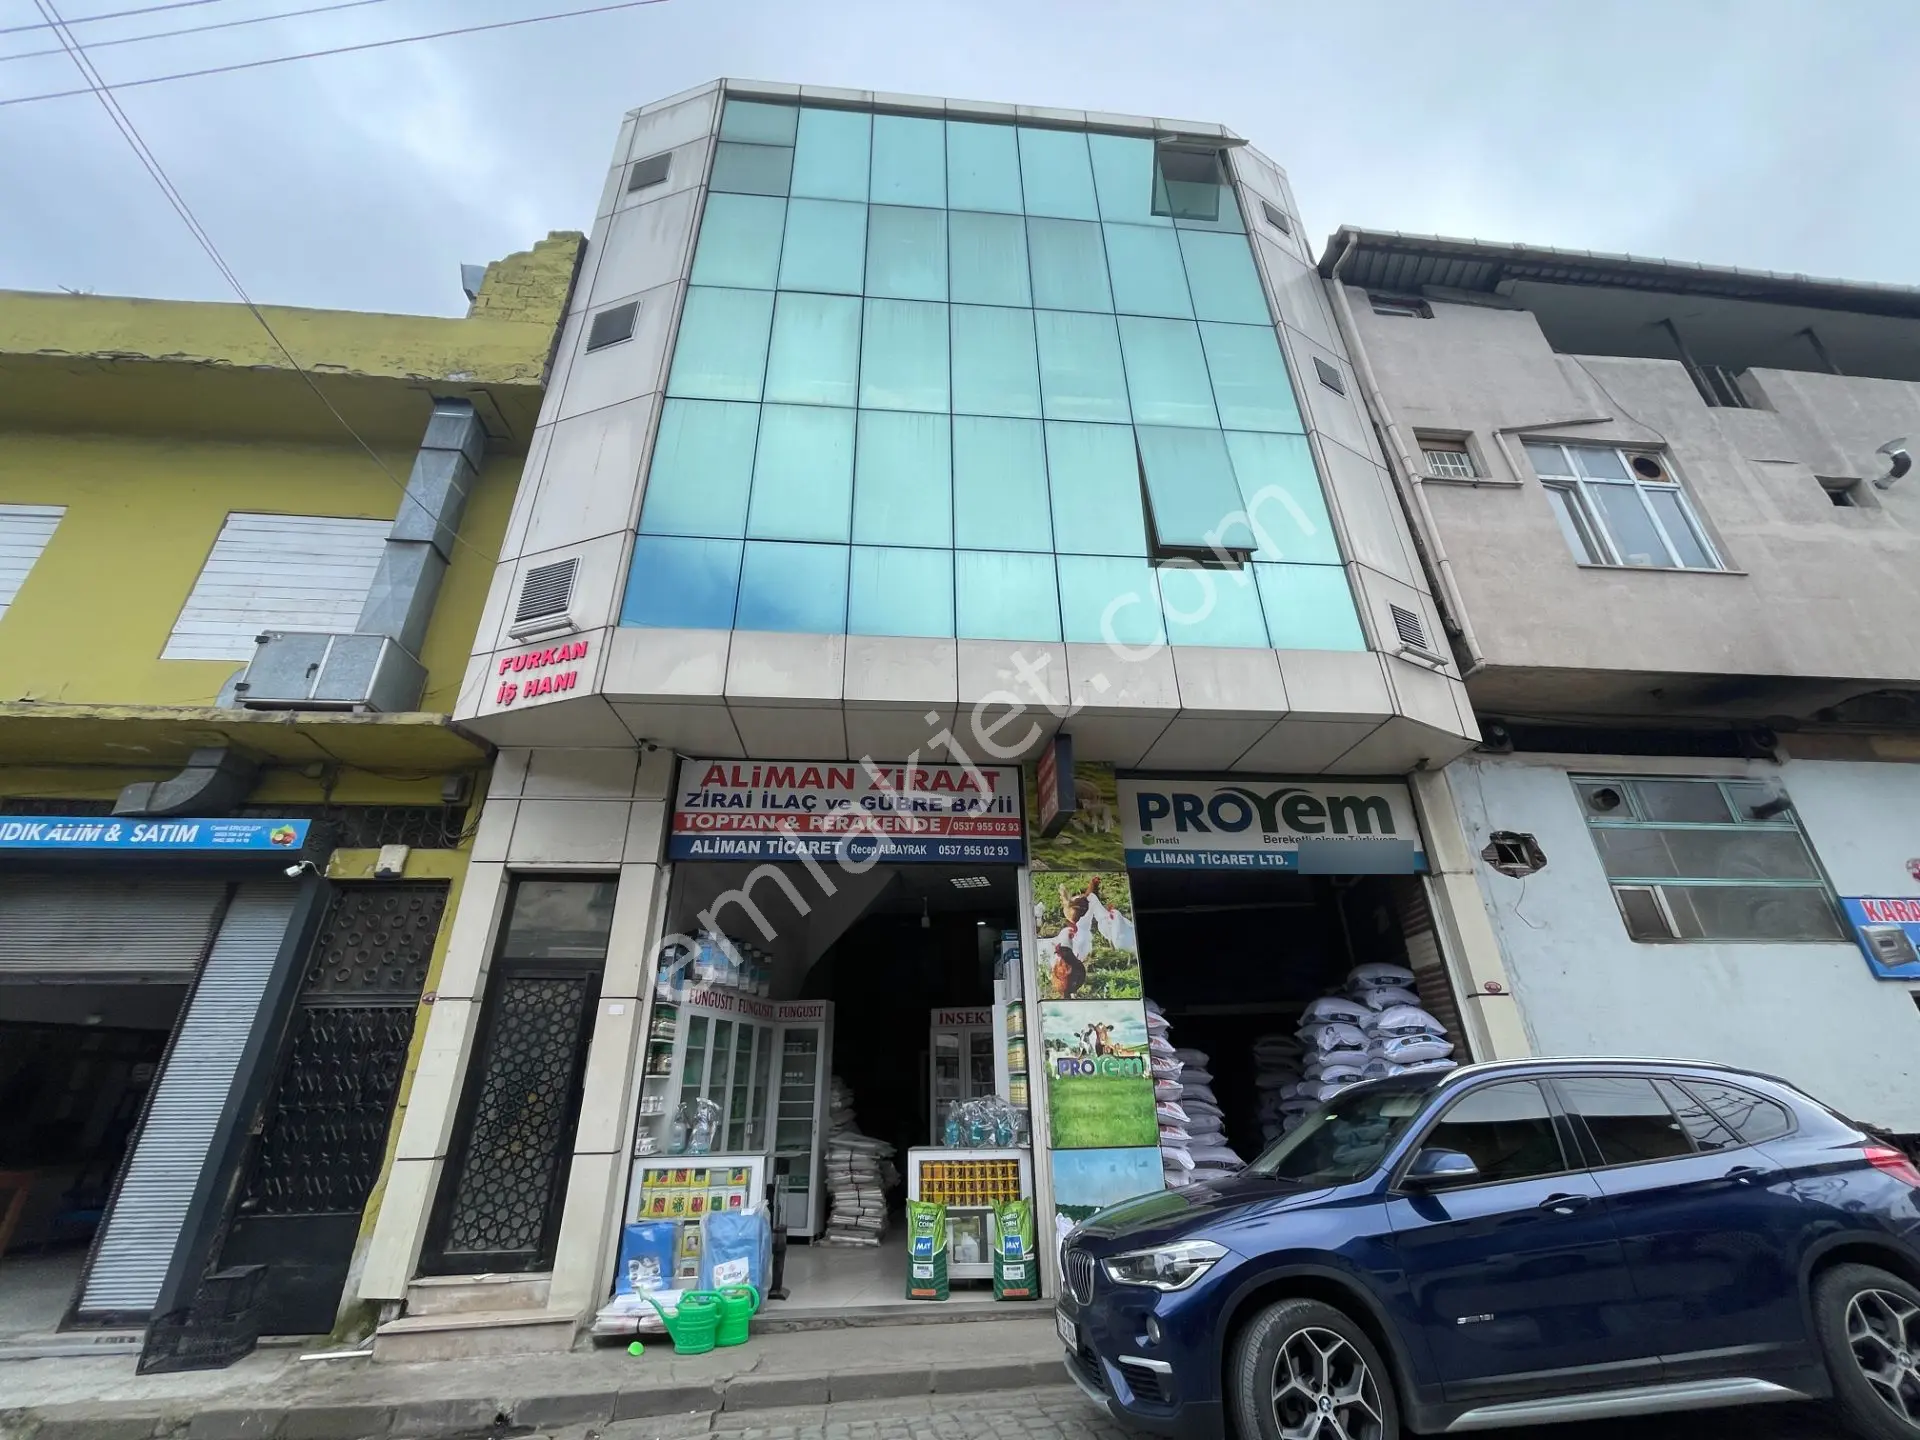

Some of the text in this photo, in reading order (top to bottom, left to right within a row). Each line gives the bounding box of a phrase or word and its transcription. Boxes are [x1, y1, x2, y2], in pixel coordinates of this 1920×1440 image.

[499, 641, 588, 675] FURKAN
[496, 671, 578, 706] İŞ HANI
[761, 790, 817, 812] İLAÇ
[825, 799, 851, 811] ve
[860, 793, 943, 813] GÜBRE
[684, 814, 1020, 833] TOPTAN & PERAKENDE 0537 955 02 93
[104, 824, 122, 842] &
[130, 824, 200, 843] SATIM
[690, 837, 1010, 856] ALİMAN TİCARET Recep ALBAYRAK 0537 955 02 93
[1144, 851, 1289, 866] ALİMAN TİCARET LTD.
[916, 1243, 931, 1251] MAY
